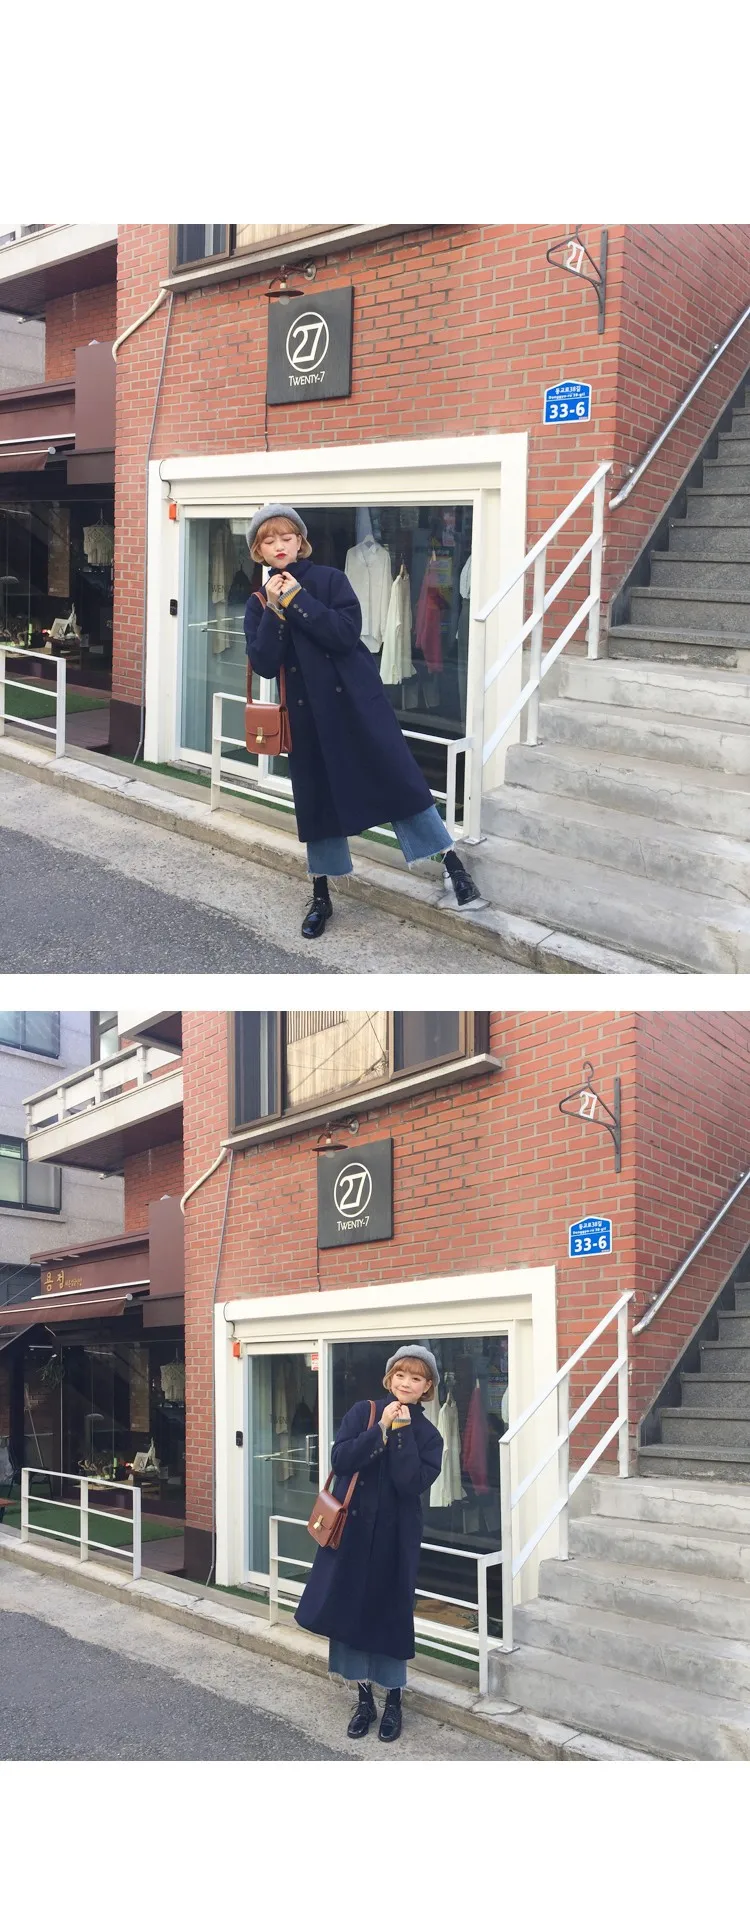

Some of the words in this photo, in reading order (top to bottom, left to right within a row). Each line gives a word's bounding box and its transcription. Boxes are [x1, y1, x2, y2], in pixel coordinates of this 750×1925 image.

[566, 241, 585, 273] 27
[292, 322, 324, 363] 27
[288, 371, 326, 387] TWENTY-7
[549, 401, 586, 419] 33-6
[579, 1090, 597, 1120] 27
[339, 1171, 368, 1210] 27
[336, 1216, 370, 1231] TWENTY-7
[574, 1235, 608, 1253] 33-6
